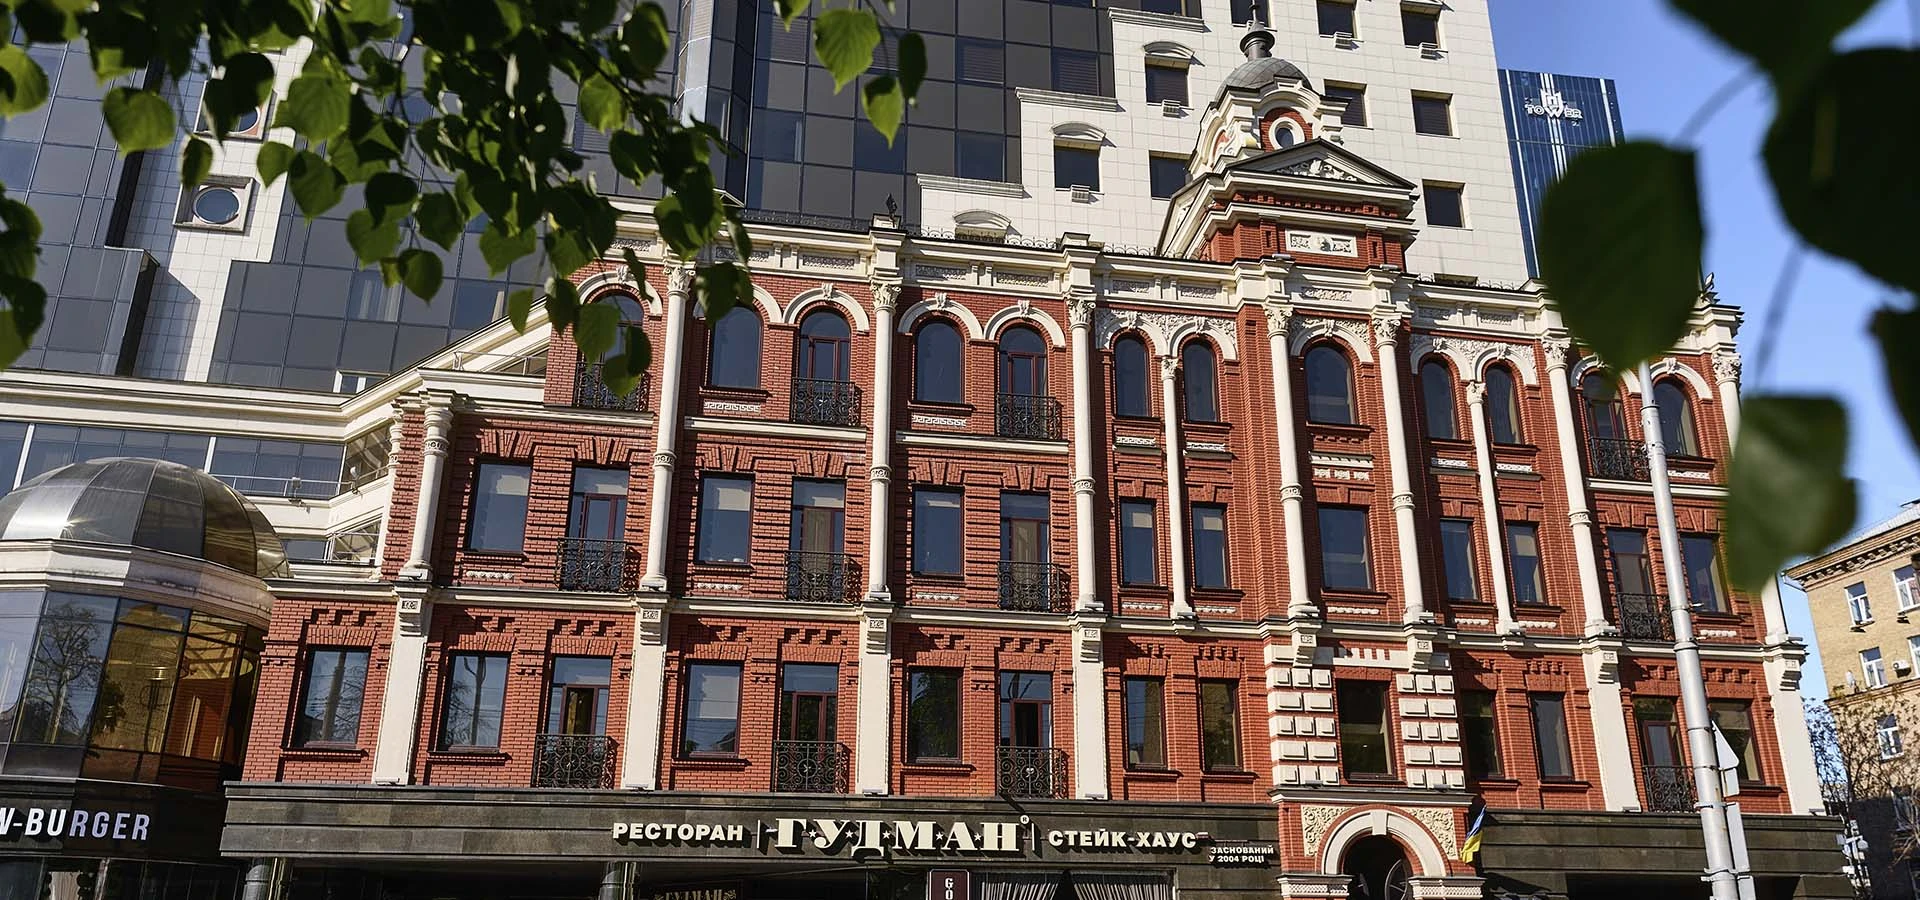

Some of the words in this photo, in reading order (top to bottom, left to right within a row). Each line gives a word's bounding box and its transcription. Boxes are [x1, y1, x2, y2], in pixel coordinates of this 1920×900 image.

[613, 823, 743, 841] РЕСТОРАН
[775, 818, 1020, 856] ГУДМАН
[1049, 829, 1196, 848] СТЕЙК-ХАУС
[1210, 845, 1274, 854] ЗАСНОВАНИЙ
[1217, 855, 1240, 863] 2004
[1241, 855, 1265, 863] РОЦІ
